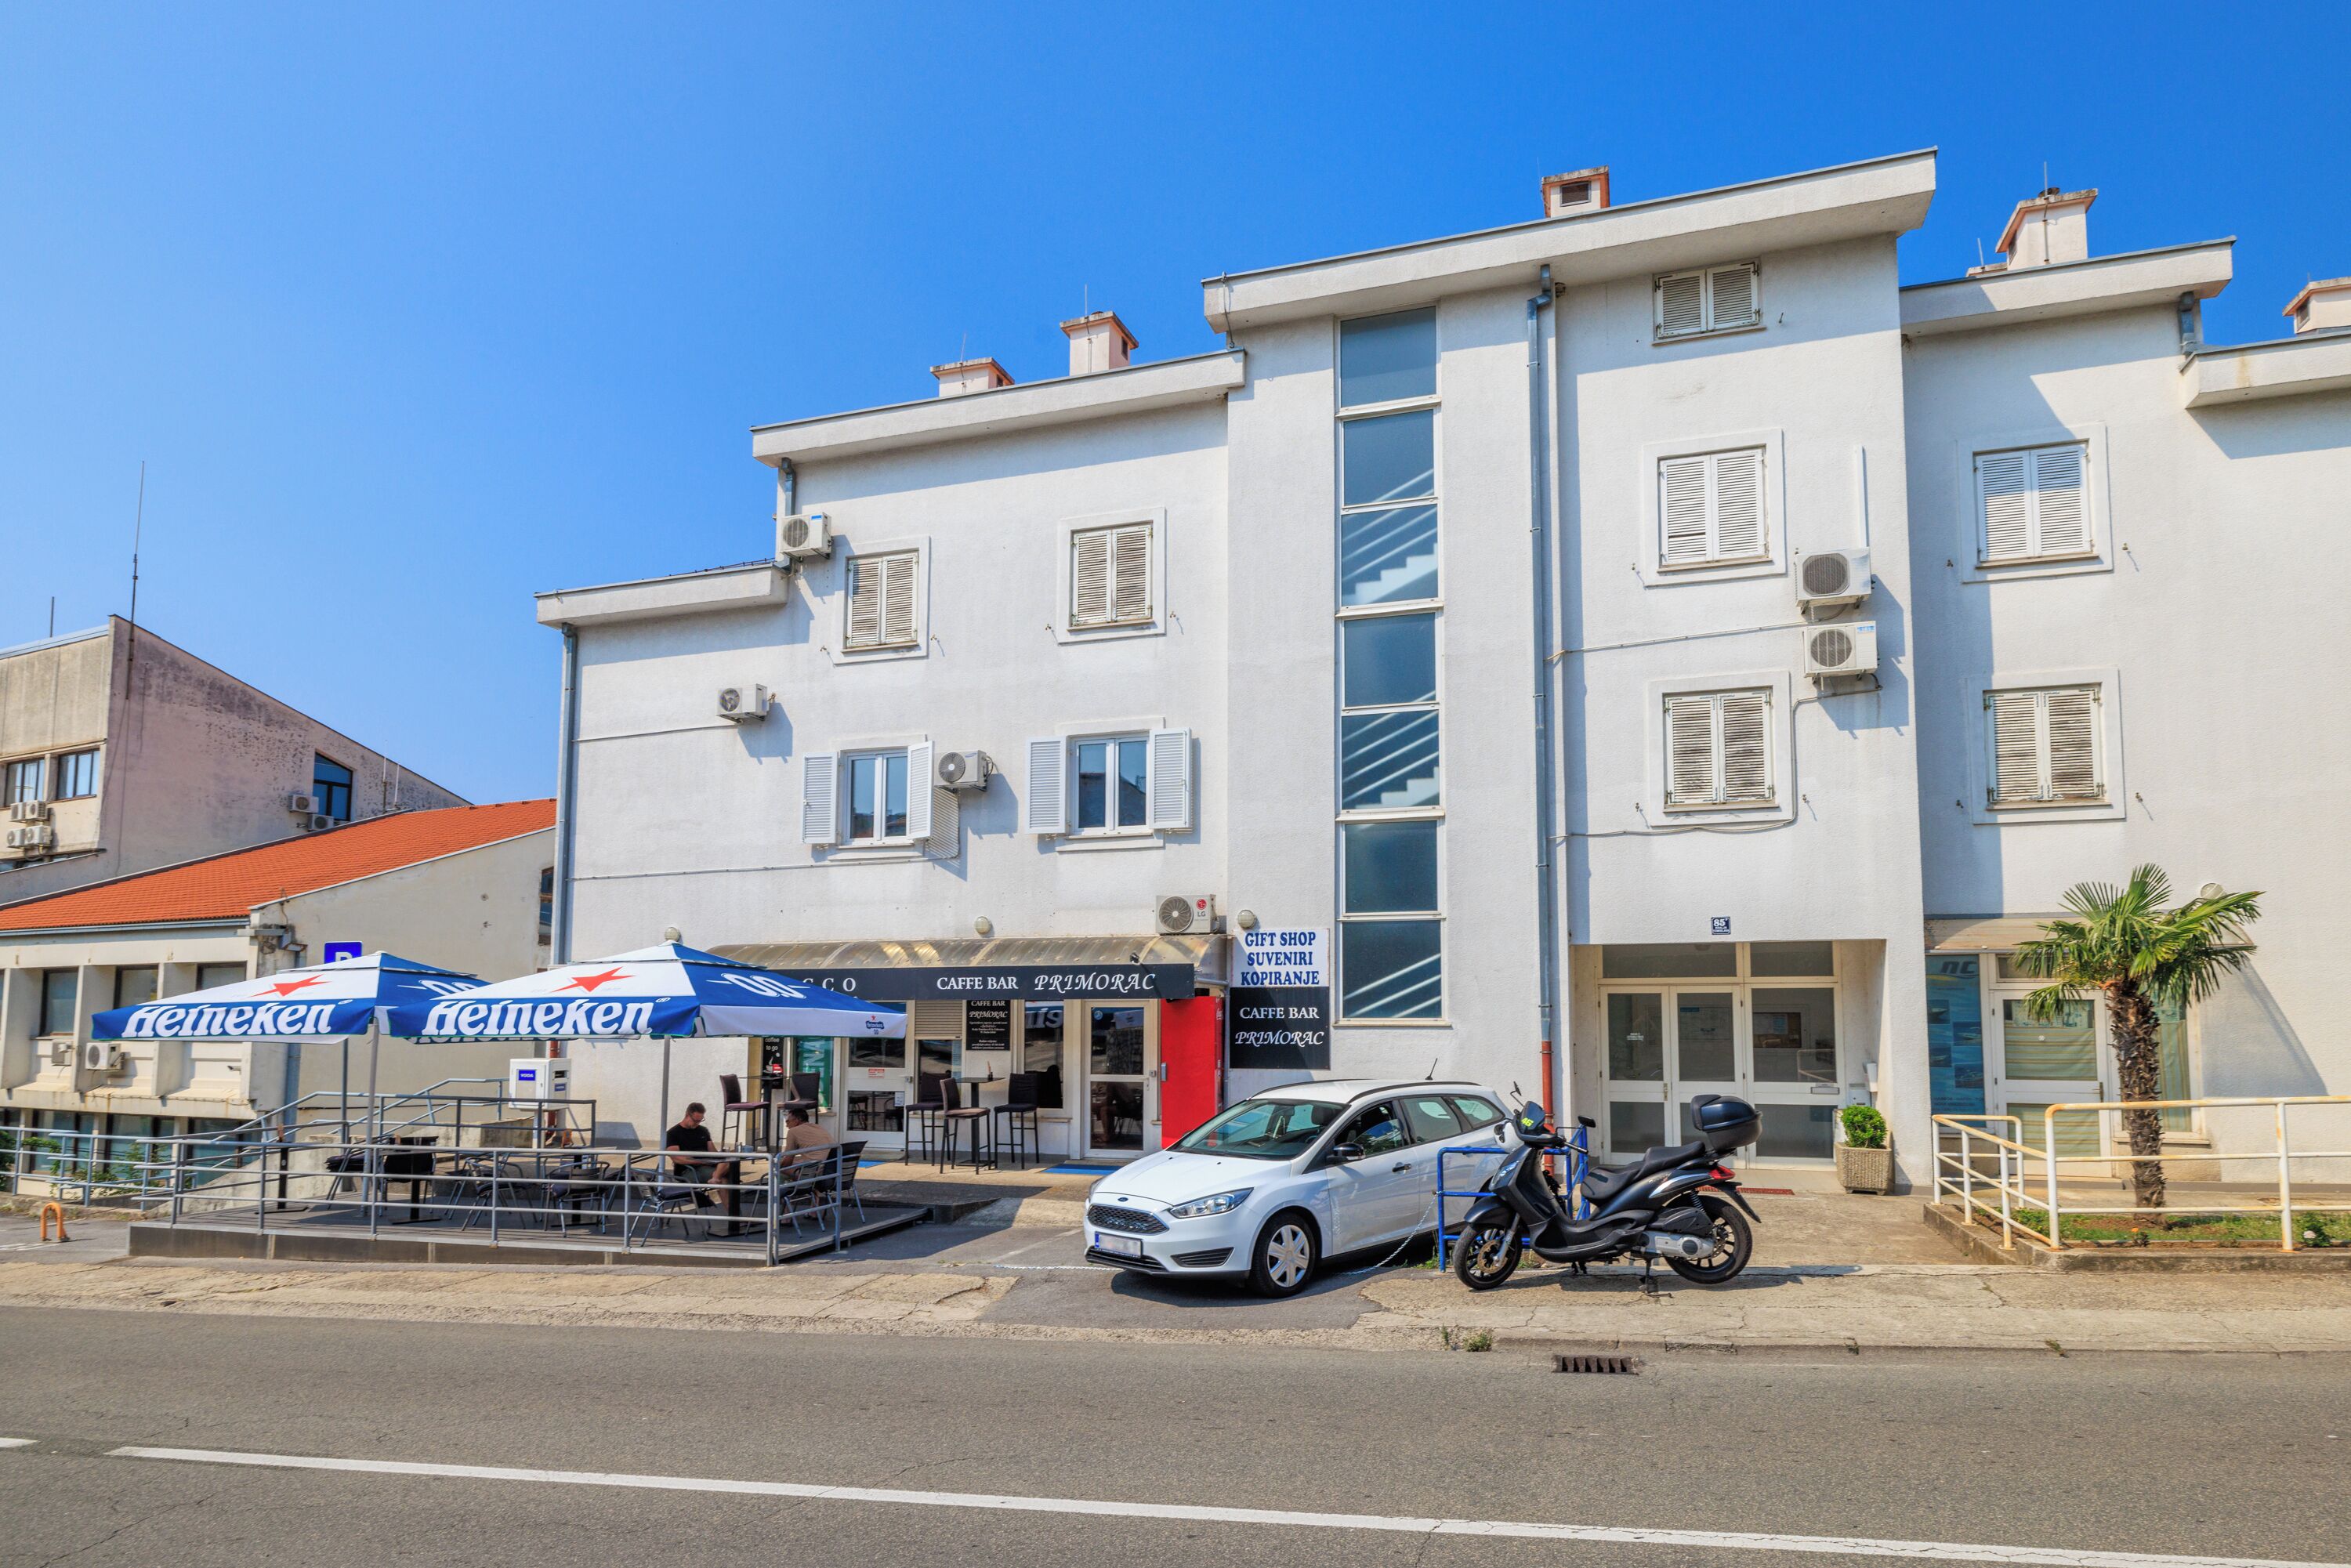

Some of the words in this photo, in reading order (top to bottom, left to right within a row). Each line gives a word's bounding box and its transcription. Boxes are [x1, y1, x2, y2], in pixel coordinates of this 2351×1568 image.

[1244, 932, 1276, 947] GIFT
[1280, 932, 1316, 946] SHOP
[1248, 951, 1313, 966] SUVENIRI
[936, 976, 983, 990] CAFFE
[987, 976, 1019, 989] BAR
[1034, 972, 1156, 993] PRIMORAC
[1241, 971, 1319, 986] KOPIRANJE
[121, 1001, 334, 1037] Heineken
[422, 998, 654, 1037] Heineken
[969, 1010, 1008, 1019] PRIMORAC
[1239, 1007, 1285, 1019] CAFFE
[1288, 1007, 1320, 1019] BAR
[1235, 1030, 1324, 1047] PRIMORAC
